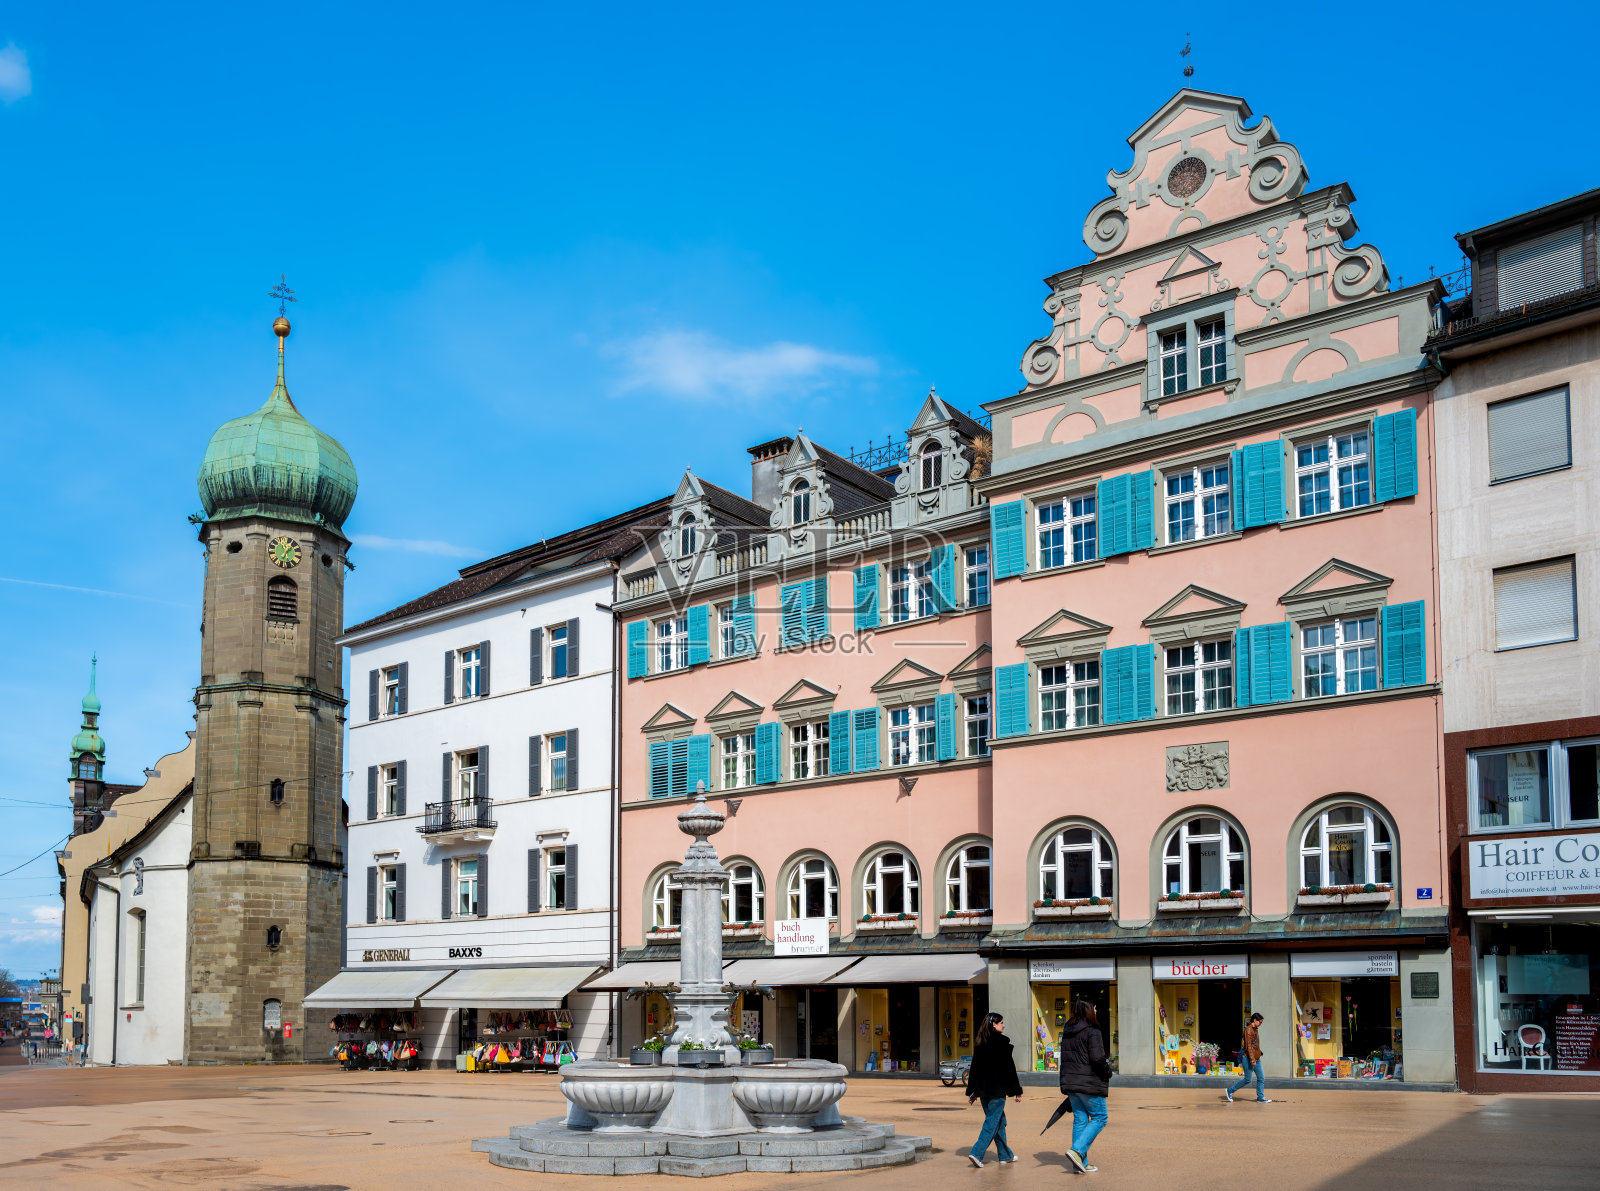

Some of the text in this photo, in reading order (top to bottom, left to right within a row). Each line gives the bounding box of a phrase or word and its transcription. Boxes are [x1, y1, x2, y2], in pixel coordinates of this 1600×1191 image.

[1478, 841, 1544, 867] Hair
[1506, 869, 1575, 882] COIFFEUR
[1579, 868, 1590, 879] &
[781, 921, 801, 931] buch
[777, 932, 815, 944] handlung
[373, 947, 482, 961] GENERALI BAXX'S
[1171, 960, 1229, 976] bücher
